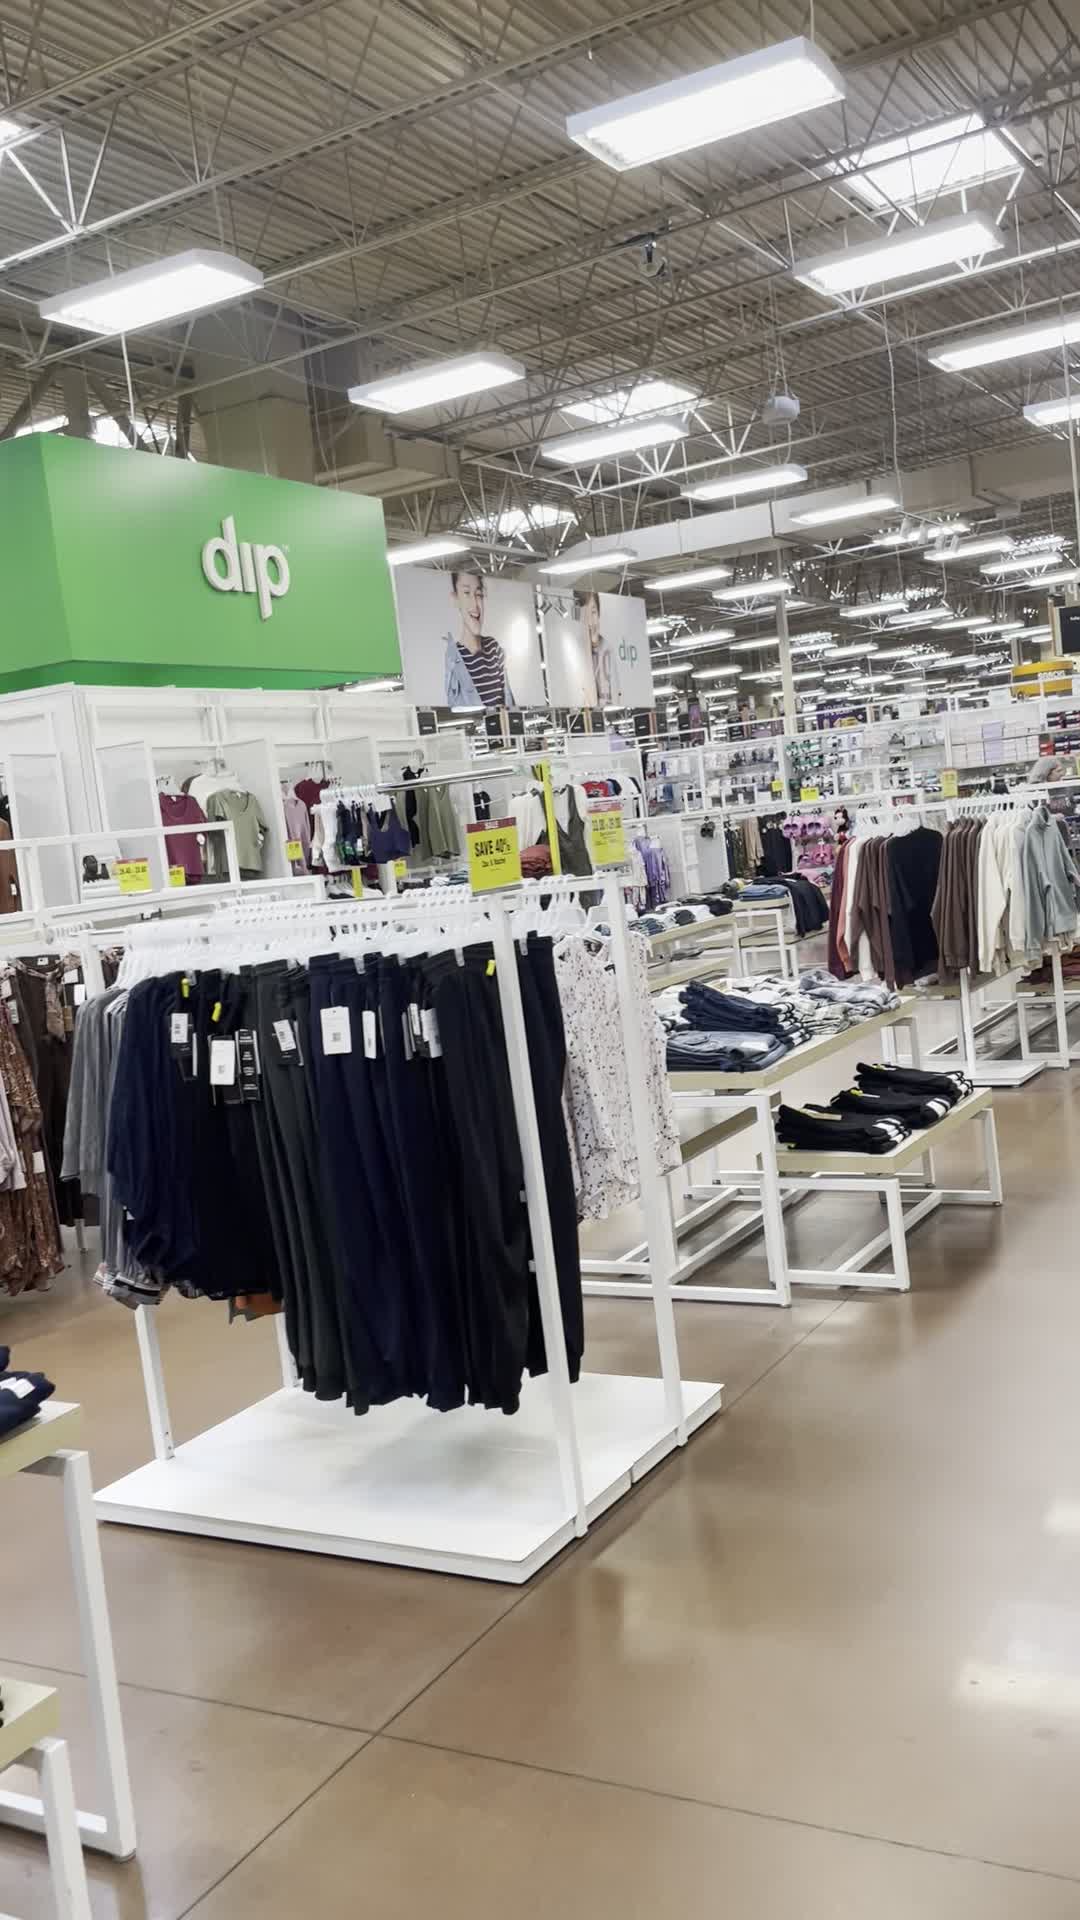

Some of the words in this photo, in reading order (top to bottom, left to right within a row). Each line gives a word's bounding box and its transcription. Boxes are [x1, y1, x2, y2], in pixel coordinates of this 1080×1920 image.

[201, 514, 290, 620] dip
[618, 637, 638, 668] dip
[474, 840, 494, 857] SAVE
